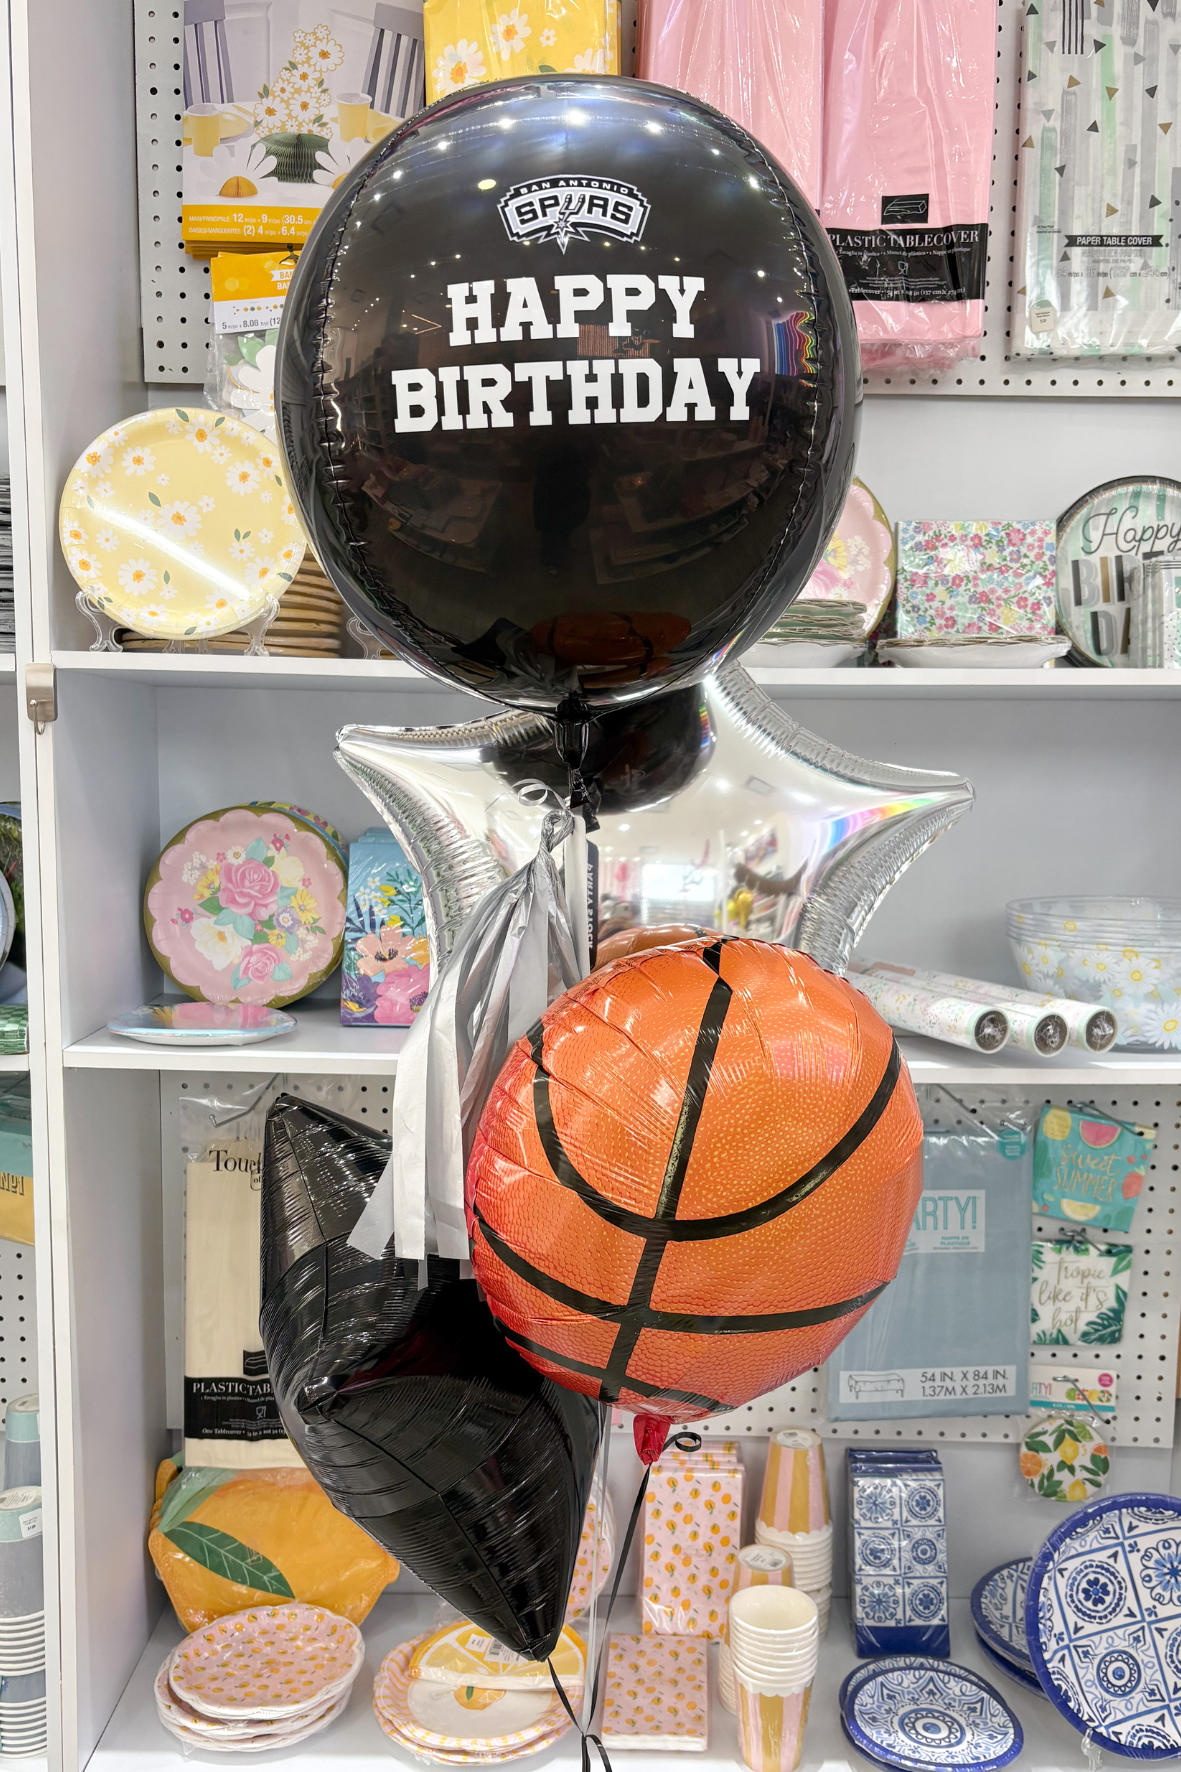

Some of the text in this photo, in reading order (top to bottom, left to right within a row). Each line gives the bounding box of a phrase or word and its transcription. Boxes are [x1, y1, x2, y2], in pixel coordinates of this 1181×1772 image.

[519, 179, 629, 195] SAN ANTONIO
[514, 193, 634, 226] SPURS
[232, 213, 244, 223] 12
[261, 213, 268, 224] 9
[282, 215, 304, 226] (30.5
[243, 225, 256, 237] (2)
[257, 225, 264, 235] 4
[281, 226, 296, 236] 6.4
[829, 230, 980, 248] PLASTIC TABLECOVER
[1076, 236, 1153, 246] PAPER TABLE COVER
[447, 274, 705, 346] HAPPY
[222, 321, 228, 330] 5
[242, 319, 259, 328] 8.08
[391, 358, 761, 433] BIRTHDAY
[1081, 505, 1181, 557] Happy
[1053, 1166, 1118, 1203] SUMMER
[1038, 1280, 1073, 1307] like
[1051, 1306, 1099, 1335] hot
[920, 1368, 1009, 1384] 54 IN. X 84 IN.
[192, 1382, 247, 1394] PLASTIC
[921, 1383, 1007, 1397] 1.37M X 2.13M
